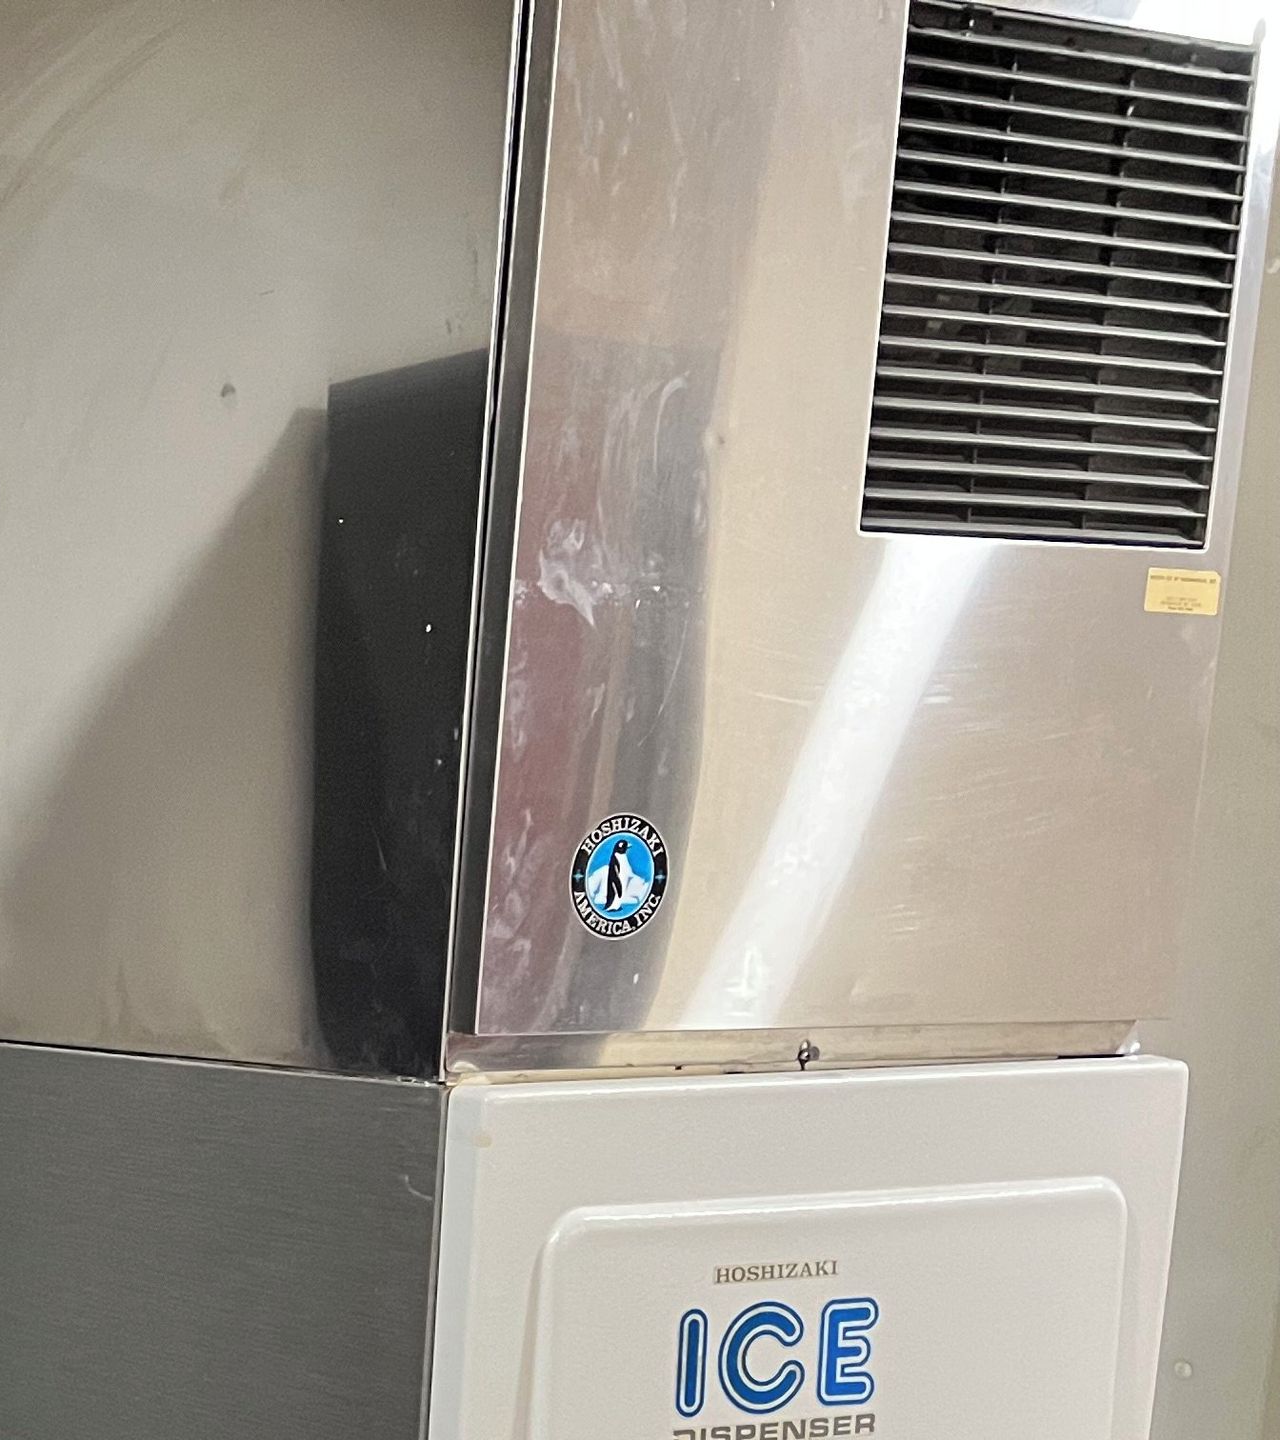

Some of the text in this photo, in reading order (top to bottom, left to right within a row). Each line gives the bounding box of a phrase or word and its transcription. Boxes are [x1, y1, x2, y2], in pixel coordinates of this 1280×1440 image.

[581, 817, 664, 857] HOSHIZAKI
[715, 1260, 839, 1284] HOSHIZAKI
[675, 1296, 879, 1418] ICE
